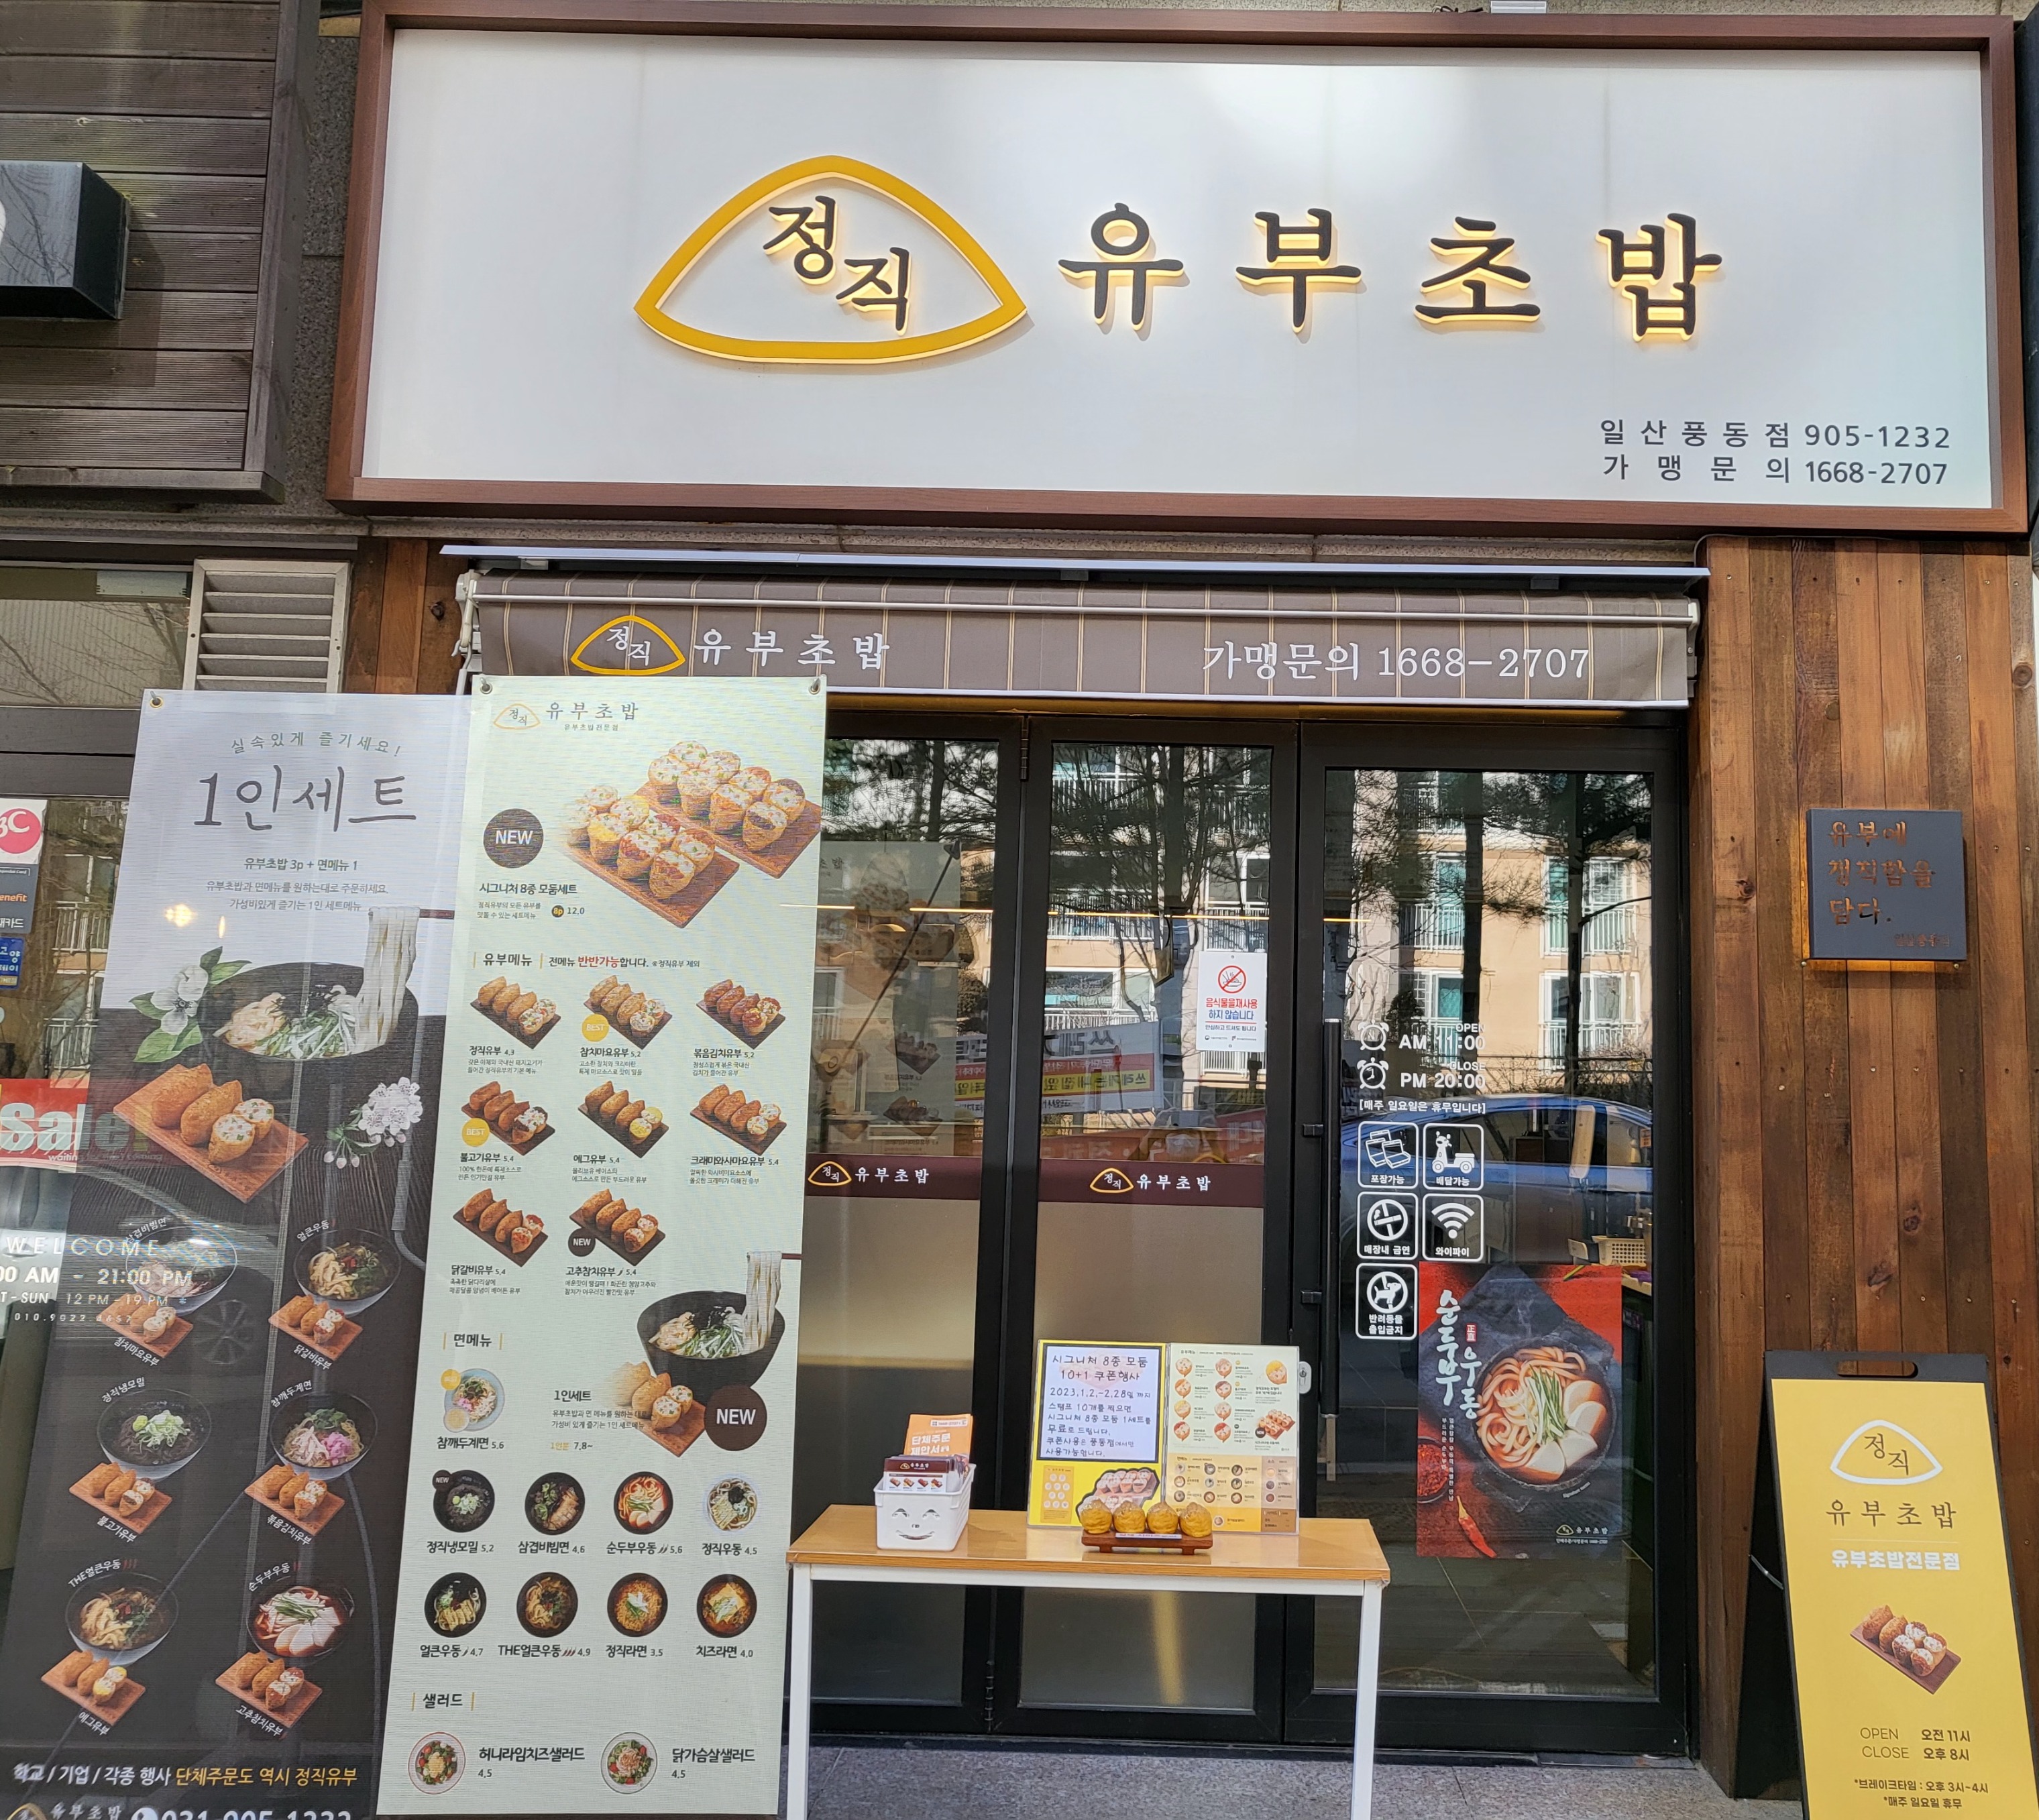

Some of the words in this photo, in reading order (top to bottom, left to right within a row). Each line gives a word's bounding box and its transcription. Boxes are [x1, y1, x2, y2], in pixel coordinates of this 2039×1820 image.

[763, 196, 910, 332] 정직
[1600, 418, 1790, 449] 일산풍동점
[1804, 424, 1951, 449] 905-1232
[1602, 453, 1791, 484] 가맹문의
[1805, 460, 1948, 486] 1668-2707
[606, 626, 651, 667] 정직
[694, 628, 891, 670] 유부초밥
[1203, 640, 1360, 681] 가맹문의
[1378, 647, 1590, 679] 1668-2707
[508, 708, 528, 726] 정직
[546, 701, 639, 720] 유부초밥
[231, 731, 305, 754] 실속있게
[319, 731, 401, 757] 즐기세요!
[193, 764, 417, 832] 1인세트
[496, 830, 533, 844] NEW
[1828, 821, 1908, 848] 유부에
[243, 858, 288, 870] 유부초밥
[290, 858, 304, 871] 3p
[317, 859, 349, 872] 면메뉴
[353, 860, 357, 870] 1
[205, 880, 253, 892] 유부초밥과
[254, 882, 291, 893] 면메뉴를
[293, 882, 339, 893] 원하는대로
[479, 883, 518, 895] 시그니처
[520, 883, 537, 895] 8종
[539, 883, 577, 895] 모둠세트
[229, 899, 276, 910] 가성비있게
[278, 899, 307, 911] 즐기는
[309, 900, 324, 911] 1인
[325, 900, 361, 911] 세트메뉴
[567, 907, 585, 915] 12.0
[483, 952, 533, 966] 유부메뉴
[549, 956, 575, 968] 전메뉴
[578, 956, 649, 968] 반반가능합니다.
[1206, 998, 1258, 1009] 음식물을재사용
[1209, 1009, 1223, 1019] 하지
[1225, 1010, 1254, 1020] 않습니다
[586, 1023, 605, 1031] BEST
[1455, 1023, 1486, 1033] OPEN
[1398, 1035, 1427, 1050] AM
[469, 1046, 502, 1056] 정직유부
[580, 1047, 629, 1058] 참치마요유부
[693, 1048, 742, 1059] 볶음김치유부
[1449, 1062, 1486, 1071] CLOSE
[1400, 1073, 1427, 1088] PM
[1434, 1073, 1486, 1089] 20:00
[1388, 1100, 1428, 1112] 일요일은
[466, 1128, 486, 1137] BEST
[460, 1153, 501, 1163] 불고기유부
[573, 1154, 607, 1164] 에그유부
[822, 1165, 840, 1183] 정직
[855, 1167, 929, 1184] 유부초밥
[1370, 1174, 1404, 1185] 포장가능
[1103, 1173, 1121, 1190] 정직
[1136, 1174, 1211, 1191] 유부초밥
[1435, 1176, 1470, 1187] 배달가능
[296, 1219, 330, 1243] 얼큰우동
[573, 1238, 591, 1246] NEW
[1364, 1245, 1390, 1255] 매장내
[1393, 1245, 1411, 1256] 금연
[1435, 1247, 1470, 1257] 와이파이
[25, 1267, 59, 1284] AM
[97, 1268, 151, 1286] 21:00
[162, 1269, 193, 1287] PM
[451, 1265, 494, 1275] 닭갈비유부
[565, 1266, 616, 1277] 고추참치유부
[88, 1294, 109, 1305] PM
[148, 1295, 168, 1306] PM
[1369, 1314, 1403, 1324] 반려동물
[1369, 1324, 1403, 1335] 출입금지
[453, 1333, 492, 1348] 면메뉴
[1435, 1289, 1461, 1407] 순두부
[293, 1344, 333, 1371] 닭갈비유부
[1052, 1355, 1097, 1365] 시그니처
[1103, 1356, 1121, 1367] 8종
[1126, 1356, 1148, 1368] 모둠
[1061, 1369, 1089, 1381] 10+1
[1095, 1370, 1140, 1382] 쿠폰행사
[1459, 1346, 1483, 1420] 우동
[101, 1377, 146, 1404] 정직냉모밀
[270, 1379, 313, 1408] 참깨두계면
[553, 1389, 592, 1403] 1인세트
[1048, 1403, 1072, 1411] 스탬프
[1077, 1404, 1105, 1413] 10개를
[1107, 1404, 1132, 1413] 찍으면
[716, 1408, 756, 1426] NEW
[1048, 1413, 1082, 1422] 시그니처
[1085, 1414, 1099, 1423] 8종
[1102, 1415, 1118, 1424] 모둠
[551, 1421, 570, 1429] 가성비
[1047, 1424, 1074, 1434] 무료로
[437, 1436, 489, 1449] 참깨두계면
[491, 1441, 504, 1449] 5.6
[1864, 1433, 1910, 1476] 정직
[1825, 1499, 1957, 1530] 유부초밥
[97, 1515, 137, 1542] 불고기유부
[266, 1514, 313, 1546] 볶음김치유부
[427, 1541, 478, 1554] 정직냉모밀
[481, 1544, 494, 1553] 5.2
[518, 1541, 569, 1554] 삼겹비빔면
[572, 1545, 586, 1554] 4.6
[606, 1541, 657, 1554] 순두부우동
[669, 1545, 683, 1554] 5.6
[702, 1543, 742, 1556] 정직우동
[745, 1547, 758, 1556] 4.5
[1831, 1549, 1961, 1571] 유부초밥전문점
[247, 1562, 290, 1593] 순두부우동
[420, 1644, 461, 1658] 얼큰우동
[470, 1648, 484, 1656] 4.7
[498, 1644, 562, 1658] THE얼큰우동
[577, 1648, 591, 1657] 4.9
[606, 1645, 647, 1658] 정직라면
[650, 1648, 663, 1657] 3.5
[696, 1645, 737, 1658] 치즈라면
[740, 1649, 754, 1658] 4.0
[423, 1693, 463, 1709] 샐러드
[78, 1711, 111, 1736] 에그유부
[235, 1705, 284, 1737] 고추참치유부
[1860, 1727, 1899, 1740] OPEN
[1921, 1729, 1944, 1742] 오전
[1947, 1729, 1971, 1743] 11시
[478, 1747, 585, 1762] 허니라임치즈샐러드
[671, 1748, 755, 1764] 닭가슴살샐러드
[1861, 1746, 1910, 1759] CLOSE
[1923, 1748, 1946, 1760] 오후
[1949, 1748, 1970, 1762] 8시
[58, 1764, 91, 1784] 기업
[103, 1766, 135, 1786] 각종
[140, 1766, 172, 1786] 행사
[176, 1766, 254, 1786] 단체주문도
[260, 1766, 290, 1786] 역시
[295, 1766, 357, 1786] 정직유부
[478, 1768, 493, 1778] 4.5
[671, 1769, 686, 1779] 4.5
[1925, 1781, 1945, 1793] 오후
[1948, 1782, 1989, 1794] 3시~4시
[1910, 1797, 1940, 1809] 일요일
[1942, 1798, 1963, 1809] 휴무
